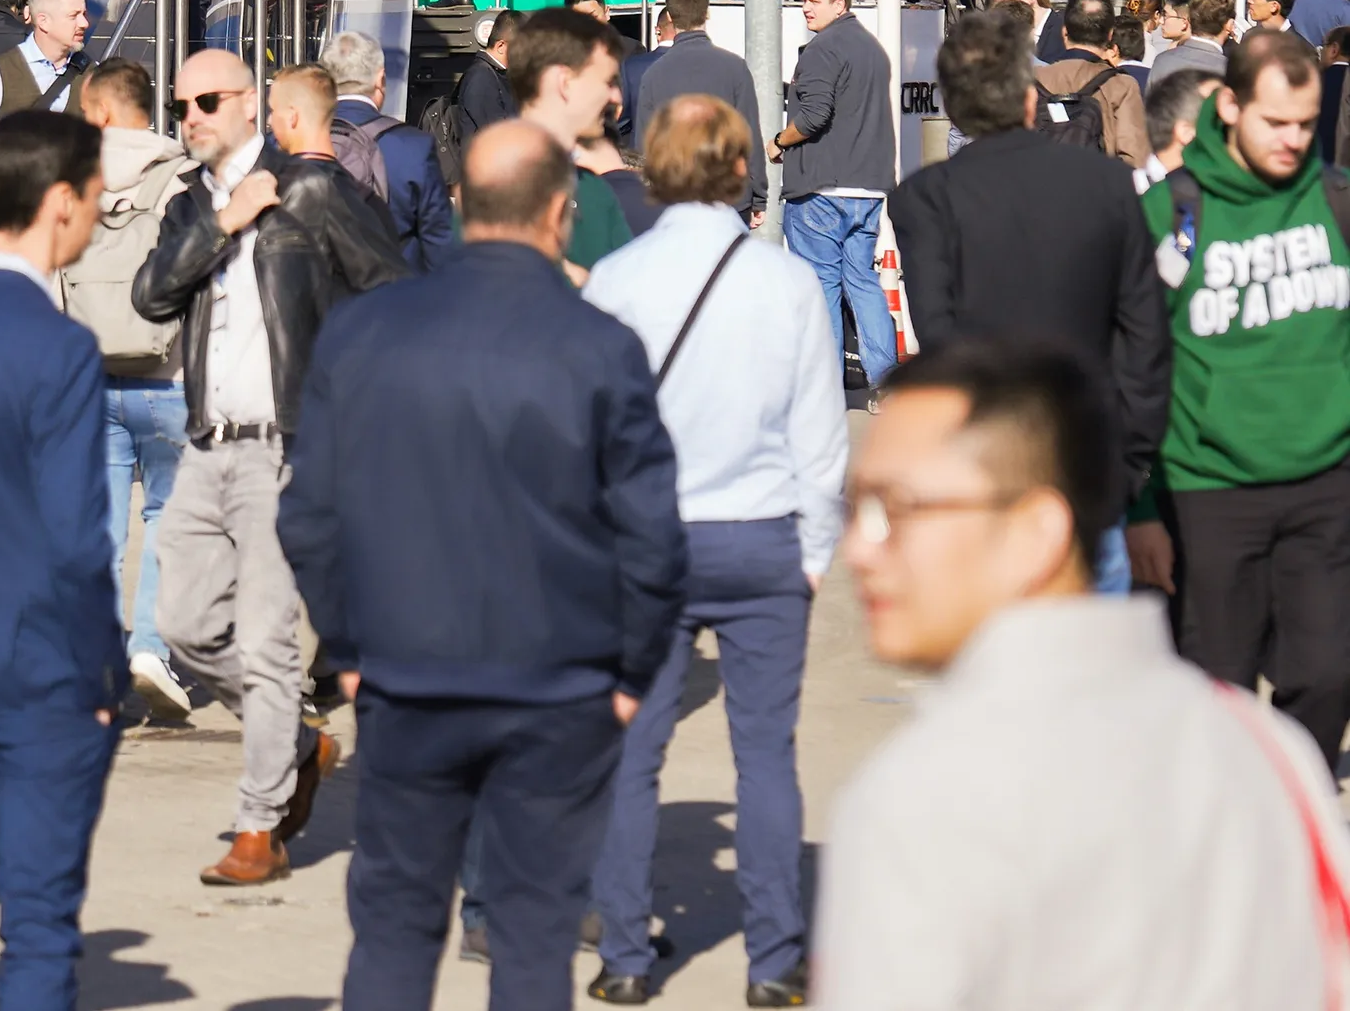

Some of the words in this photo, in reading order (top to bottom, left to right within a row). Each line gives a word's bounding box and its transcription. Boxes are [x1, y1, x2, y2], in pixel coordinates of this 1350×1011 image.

[901, 82, 940, 114] CRRC
[1204, 223, 1332, 289] SYSTEM
[1189, 287, 1240, 337] OF
[1241, 281, 1271, 329] A
